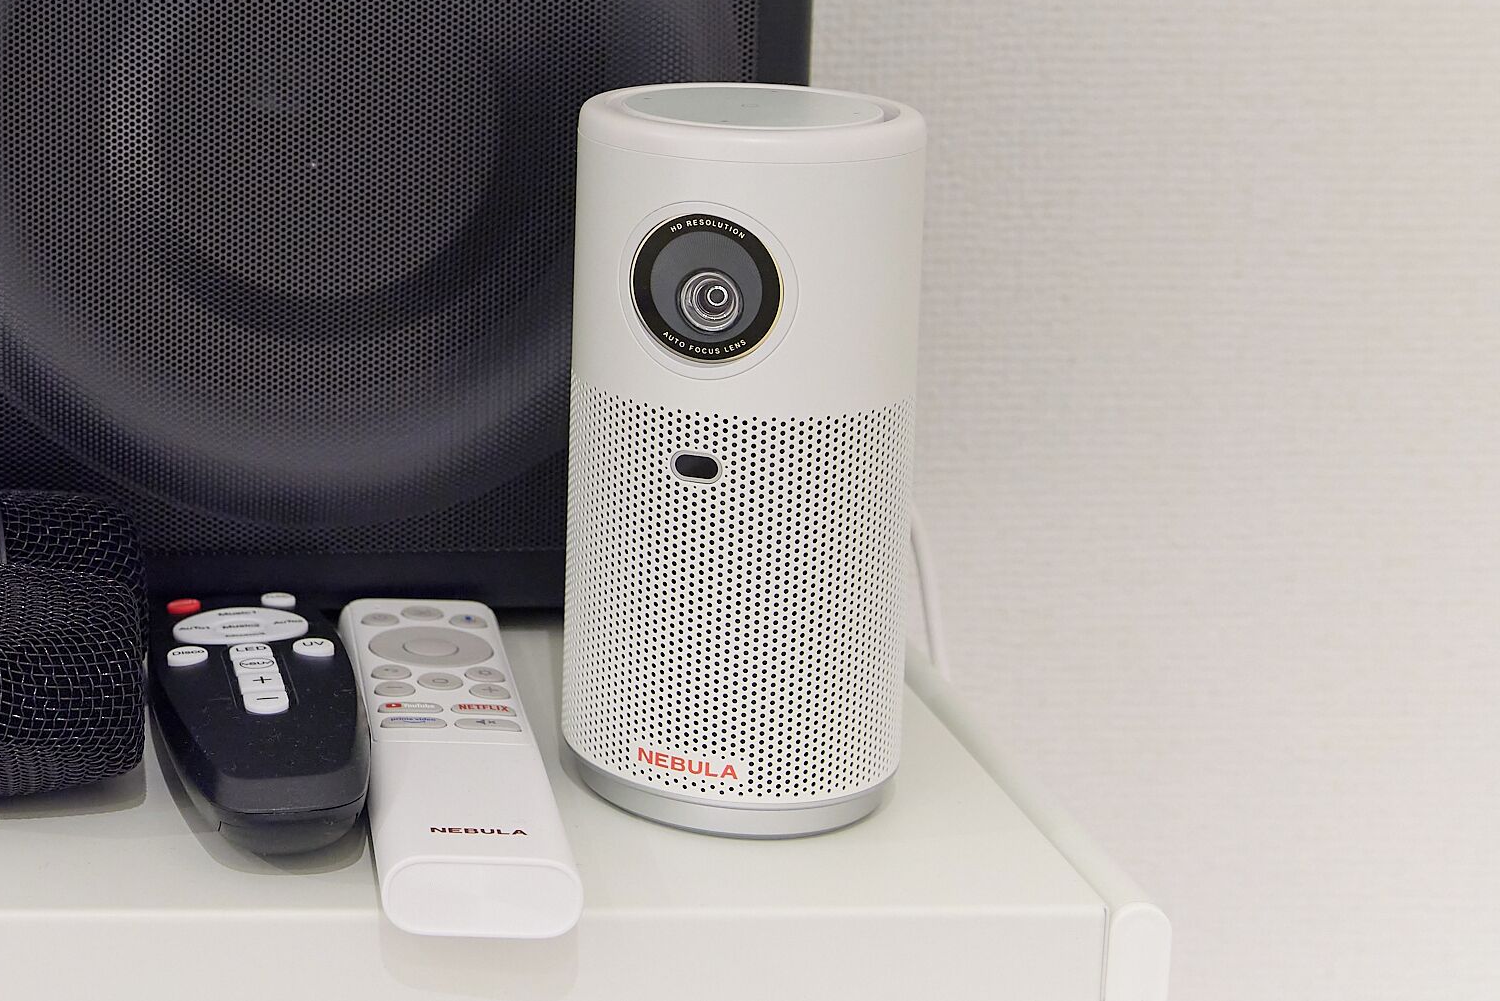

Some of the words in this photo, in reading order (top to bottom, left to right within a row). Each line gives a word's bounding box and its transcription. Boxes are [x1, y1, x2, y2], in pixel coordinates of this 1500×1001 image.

[670, 223, 683, 233] HD
[686, 218, 746, 239] RESOLUTION
[663, 331, 686, 348] AUTO
[688, 344, 721, 355] FOCUS
[723, 339, 747, 353] LENS
[458, 703, 509, 712] NETFLIX
[637, 747, 738, 780] NEBULA
[430, 827, 528, 836] NEBULA
